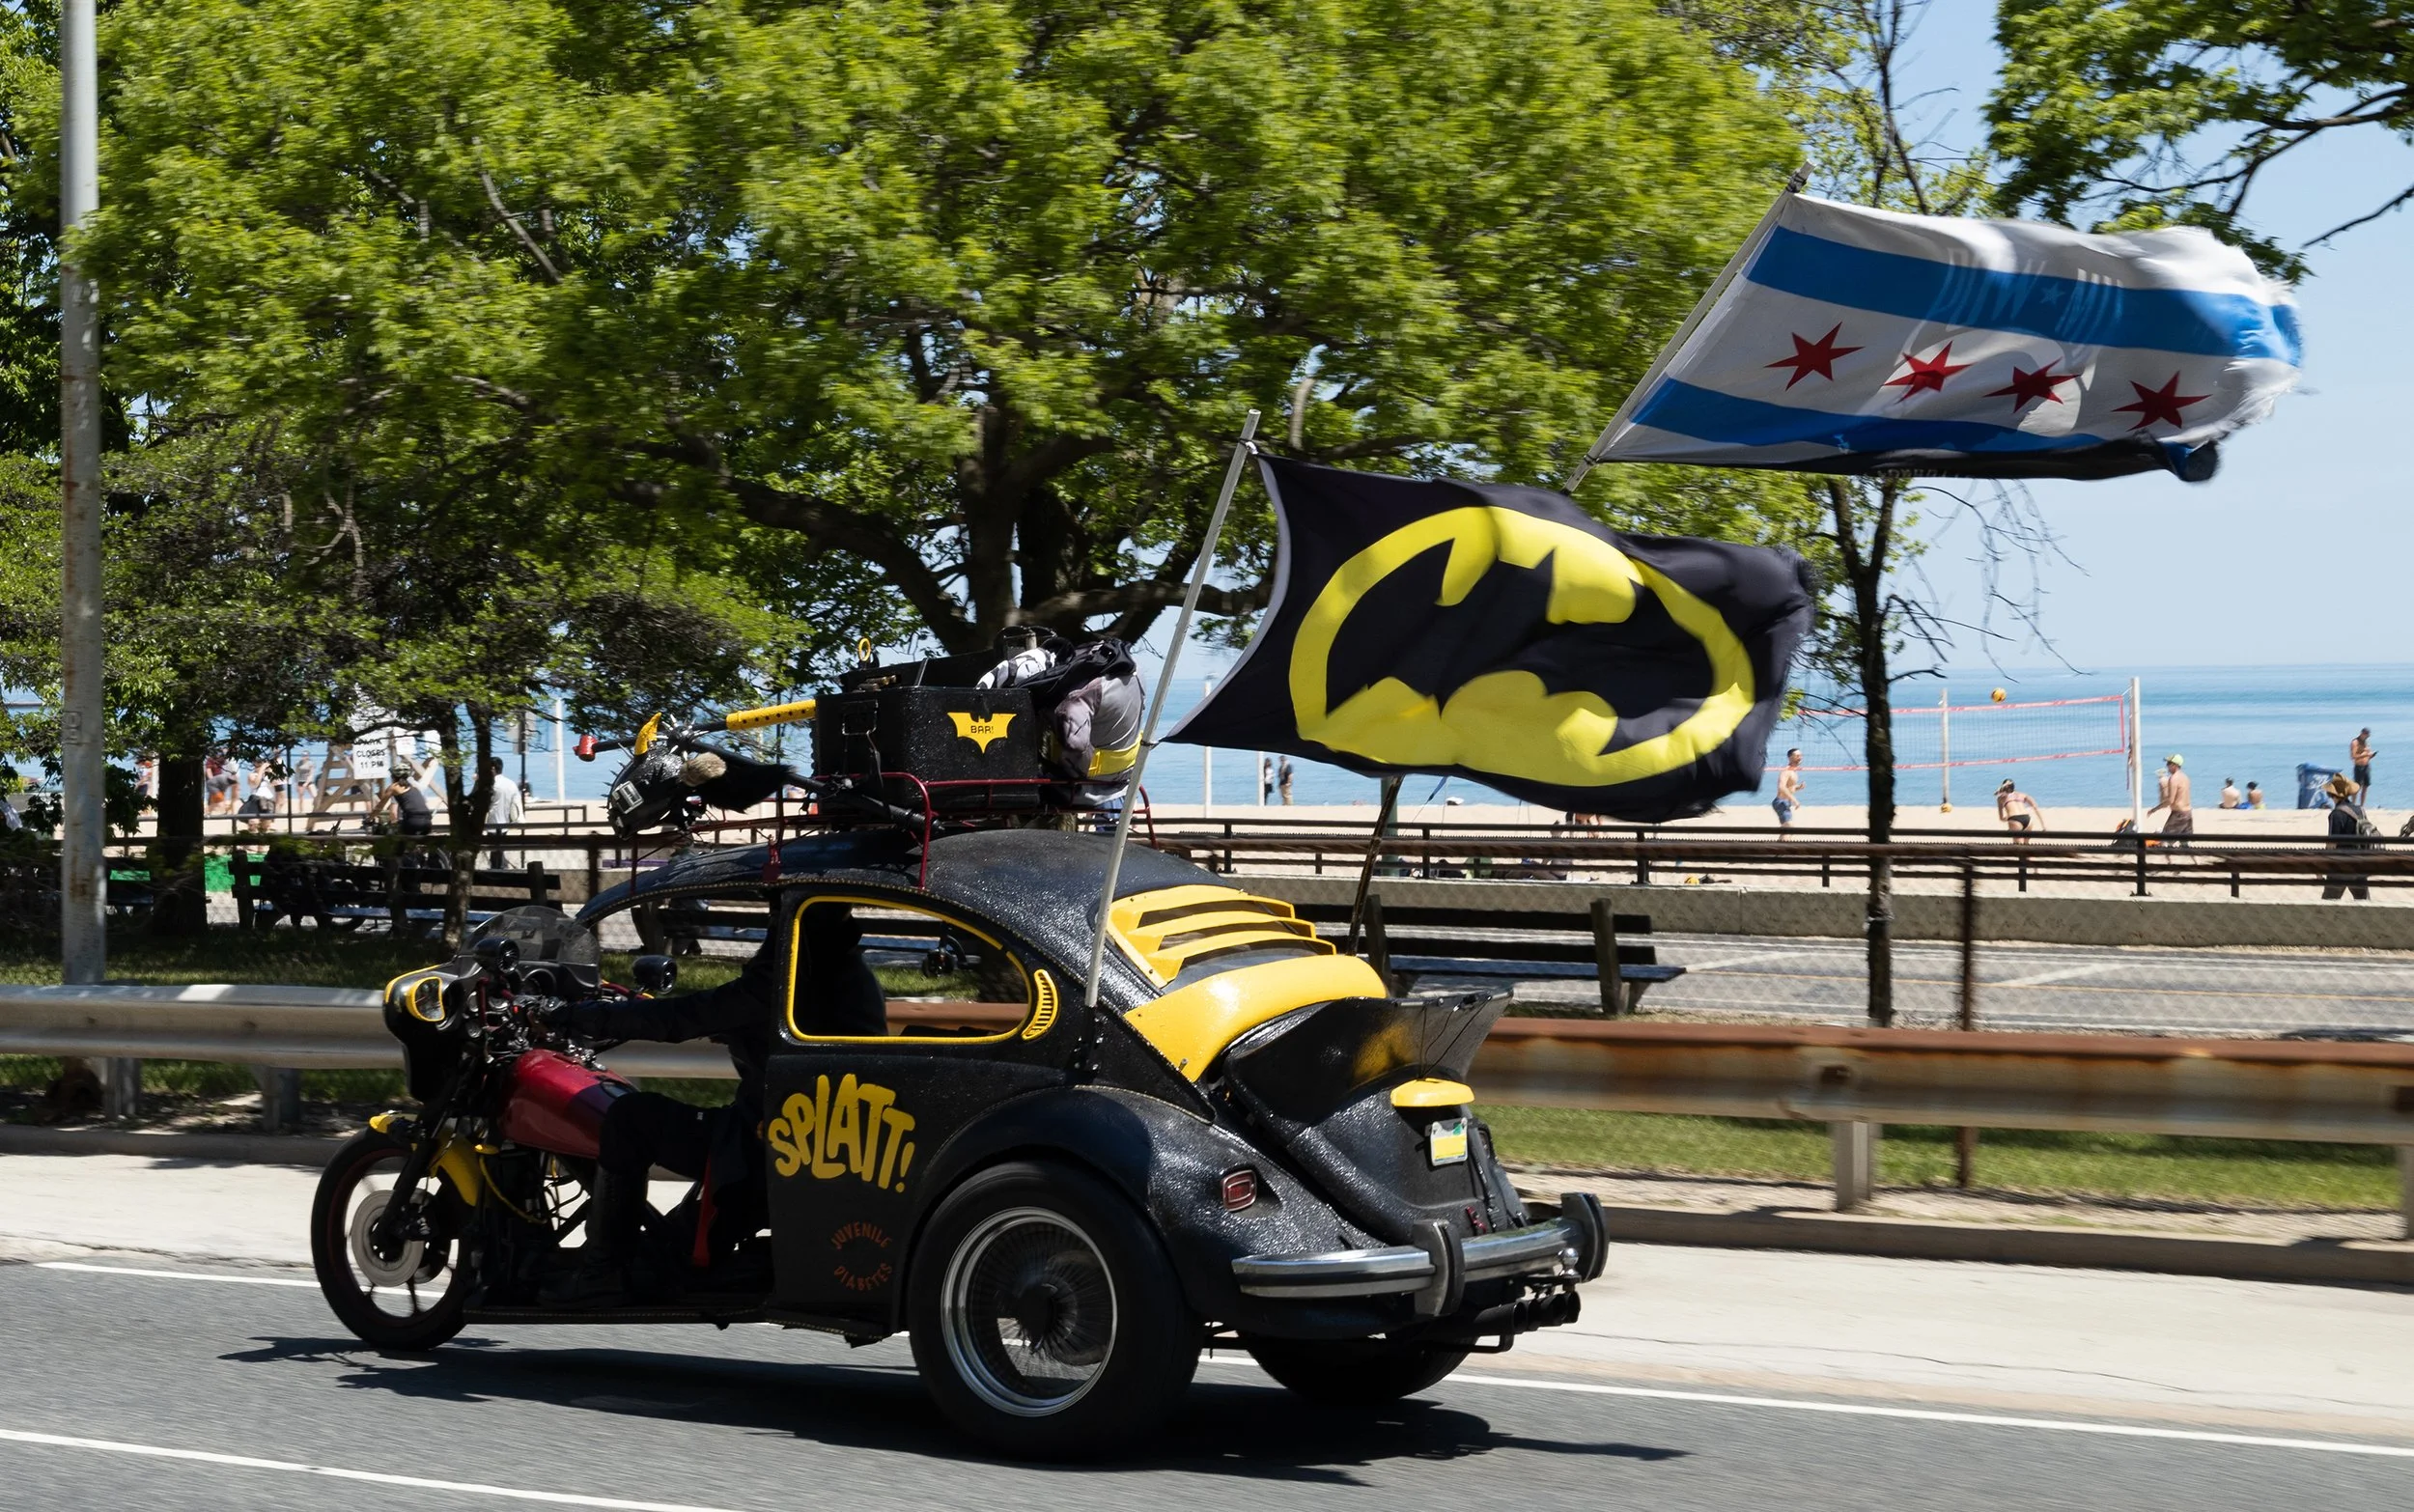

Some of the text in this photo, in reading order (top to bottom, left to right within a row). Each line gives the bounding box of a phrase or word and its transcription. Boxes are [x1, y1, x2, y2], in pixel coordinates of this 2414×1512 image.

[970, 725, 995, 735] BAR!
[356, 749, 385, 758] CLOSES
[768, 1073, 916, 1192] SPLATT!
[830, 1221, 893, 1249] JUVENILE
[833, 1263, 893, 1291] DIABETES
